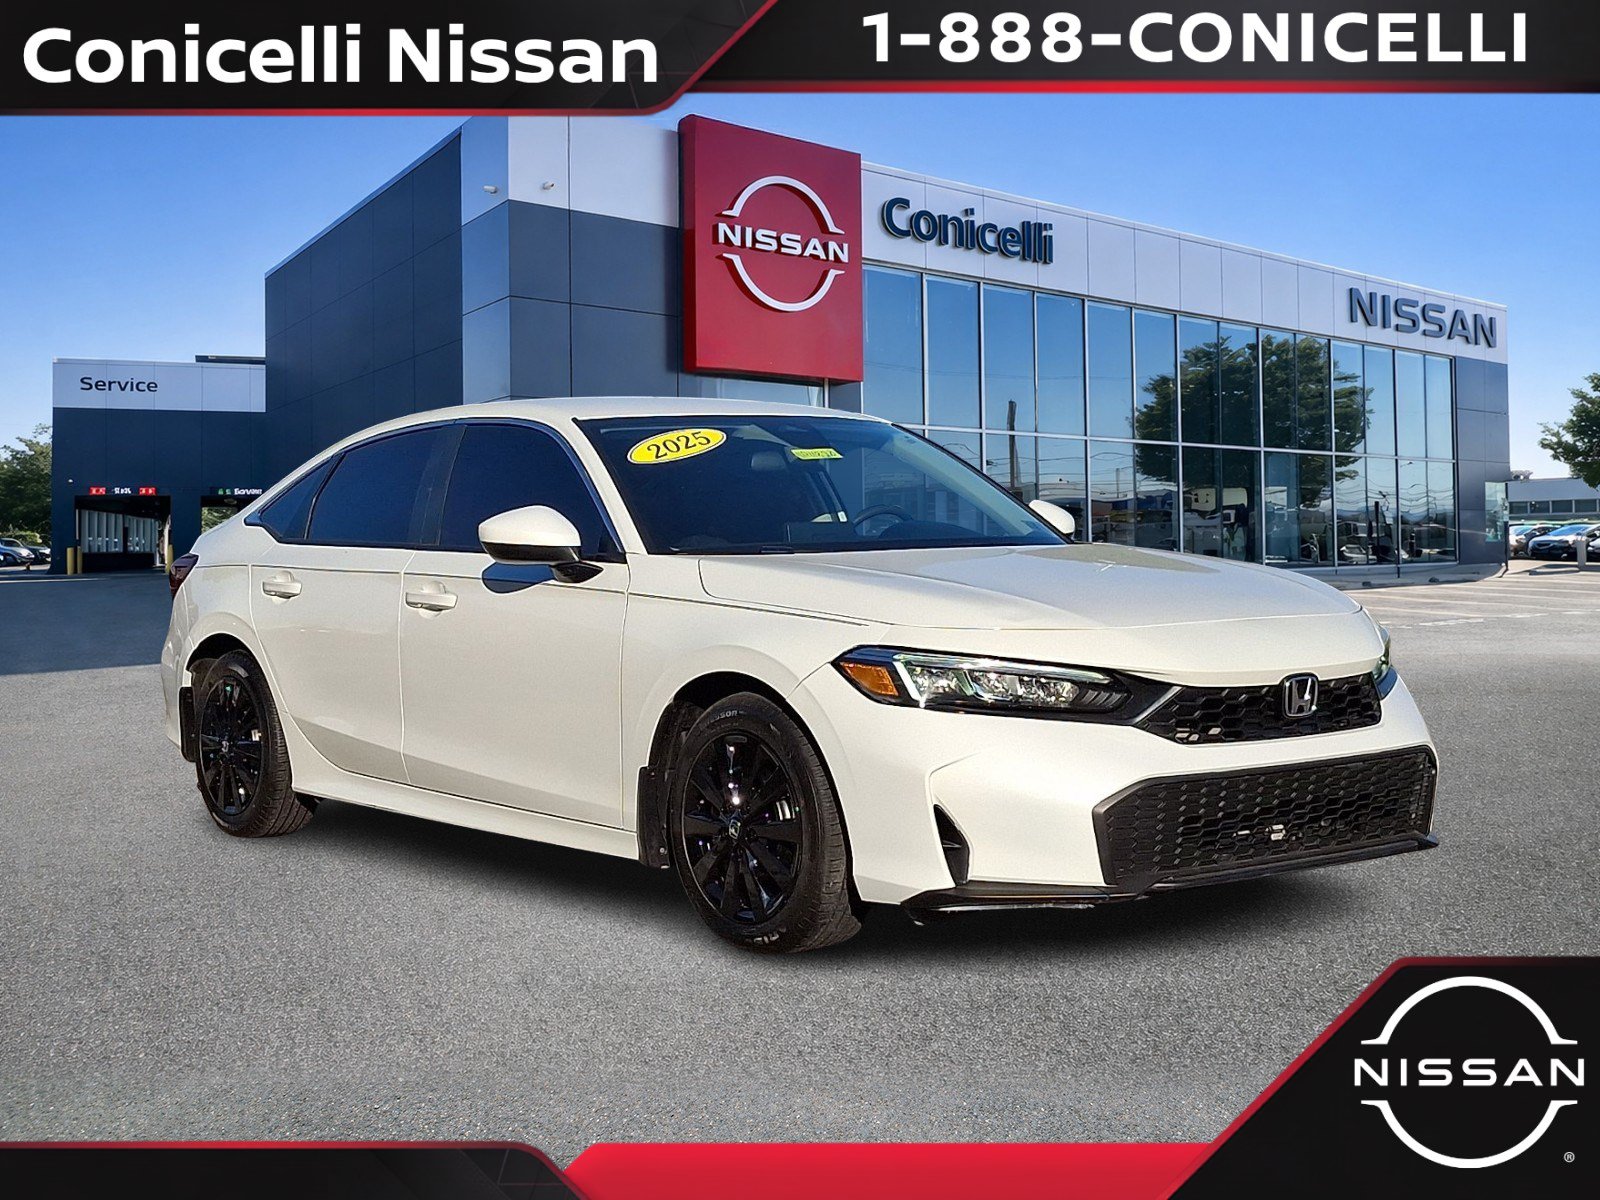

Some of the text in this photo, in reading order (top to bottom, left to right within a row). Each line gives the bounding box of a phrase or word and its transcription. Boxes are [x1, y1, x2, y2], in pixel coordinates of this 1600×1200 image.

[718, 222, 849, 264] NISSAN
[882, 197, 1054, 265] Conicelli
[1349, 287, 1497, 348] NISSAN
[80, 376, 158, 392] Service
[646, 431, 711, 460] 2025
